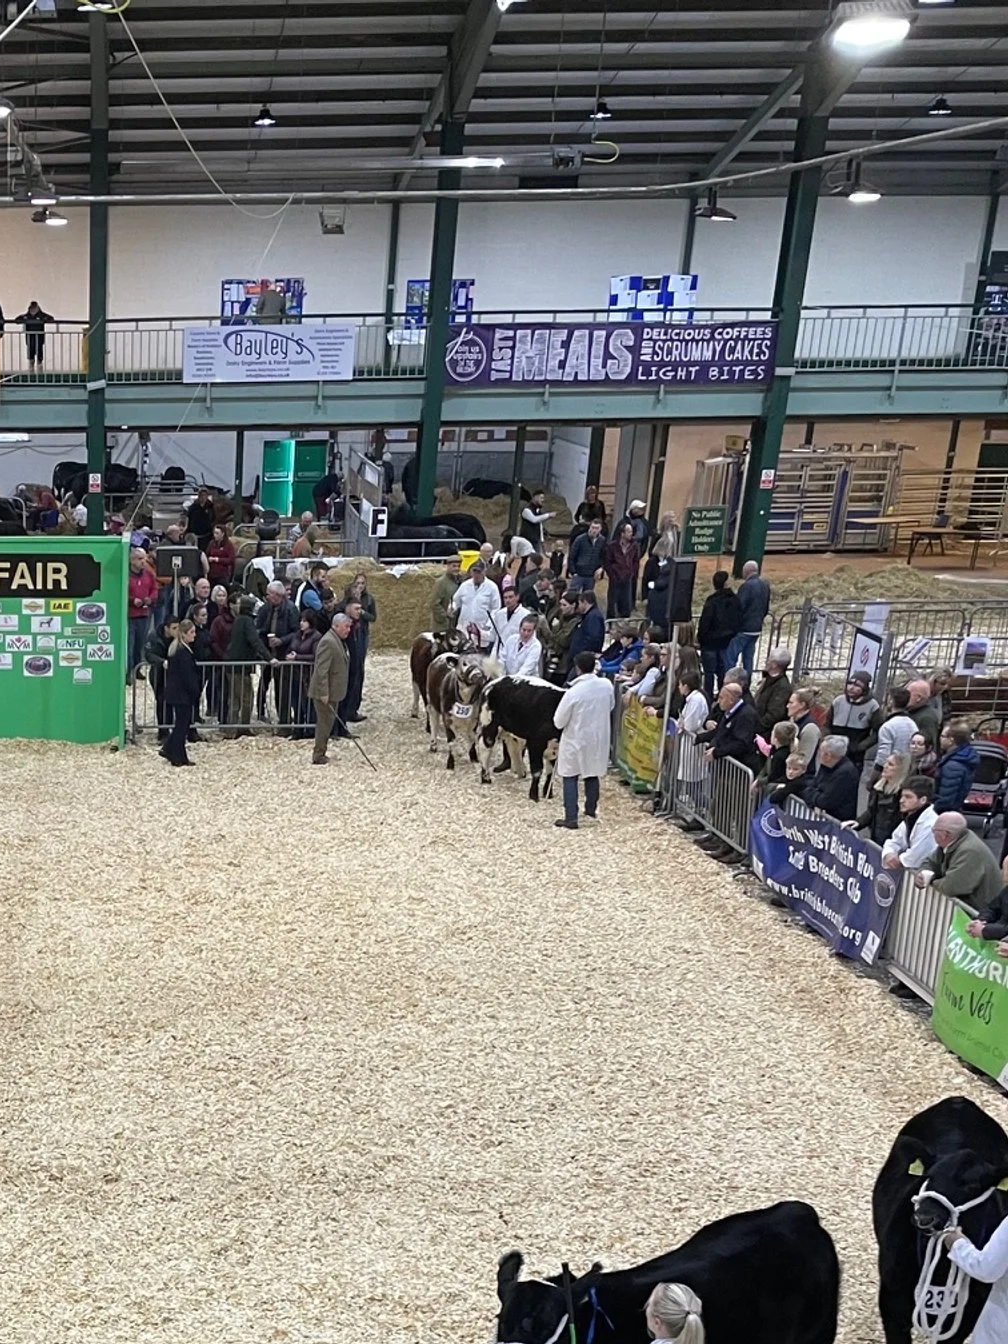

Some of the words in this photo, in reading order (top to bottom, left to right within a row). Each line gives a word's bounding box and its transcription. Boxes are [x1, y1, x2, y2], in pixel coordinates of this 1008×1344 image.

[642, 328, 711, 340] DELICIOUS
[714, 327, 773, 339] COFFEES
[234, 331, 304, 360] Bayley's
[490, 328, 515, 381] TASTY
[512, 329, 635, 381] MEALS
[640, 340, 654, 361] AND
[653, 341, 724, 362] SCRUMMY
[725, 340, 771, 361] CAKES
[637, 365, 700, 380] LIGHT
[708, 365, 766, 381] BITES
[371, 509, 386, 536] F
[702, 510, 722, 518] Public
[52, 602, 71, 610] IAE
[65, 639, 84, 648] NFU
[803, 829, 830, 851] Wst
[970, 988, 994, 1026] Vets
